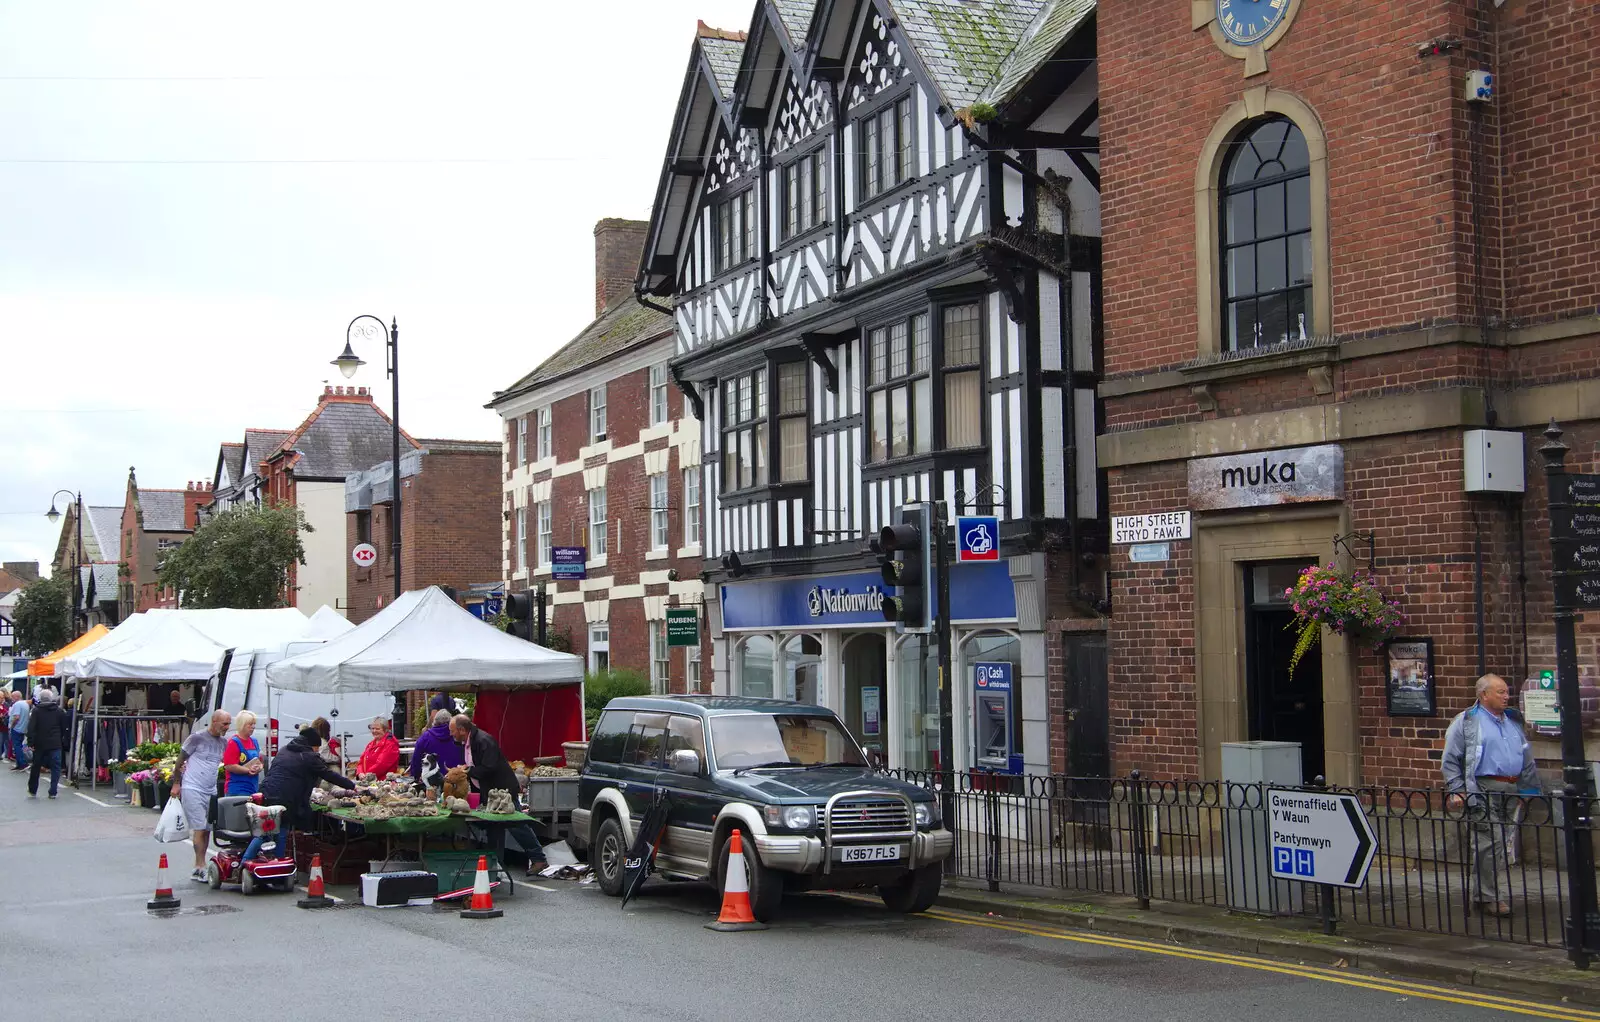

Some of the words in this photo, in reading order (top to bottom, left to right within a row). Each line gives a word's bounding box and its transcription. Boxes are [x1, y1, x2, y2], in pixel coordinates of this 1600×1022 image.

[1221, 458, 1296, 488] muka
[1250, 486, 1267, 496] HAIR
[1269, 483, 1297, 494] DESIGN
[1116, 516, 1143, 529] HIGH
[1147, 512, 1186, 527] STREET
[1116, 528, 1149, 542] STRYD
[1153, 526, 1182, 540] FAWR
[1580, 545, 1599, 554] Bailey
[1581, 558, 1596, 568] Bryn
[821, 585, 884, 613] Nationwide
[668, 616, 697, 624] RUBENS
[988, 666, 1004, 679] Cash
[989, 681, 1010, 689] withdrawals
[1272, 795, 1337, 812] Gwernaffield
[1272, 809, 1280, 821] Y
[1281, 810, 1310, 824] Waun
[1273, 831, 1332, 850] Pantymwyn
[846, 848, 874, 861] K967
[875, 847, 896, 859] FLS
[1278, 849, 1290, 871] P
[1297, 852, 1312, 874] H
